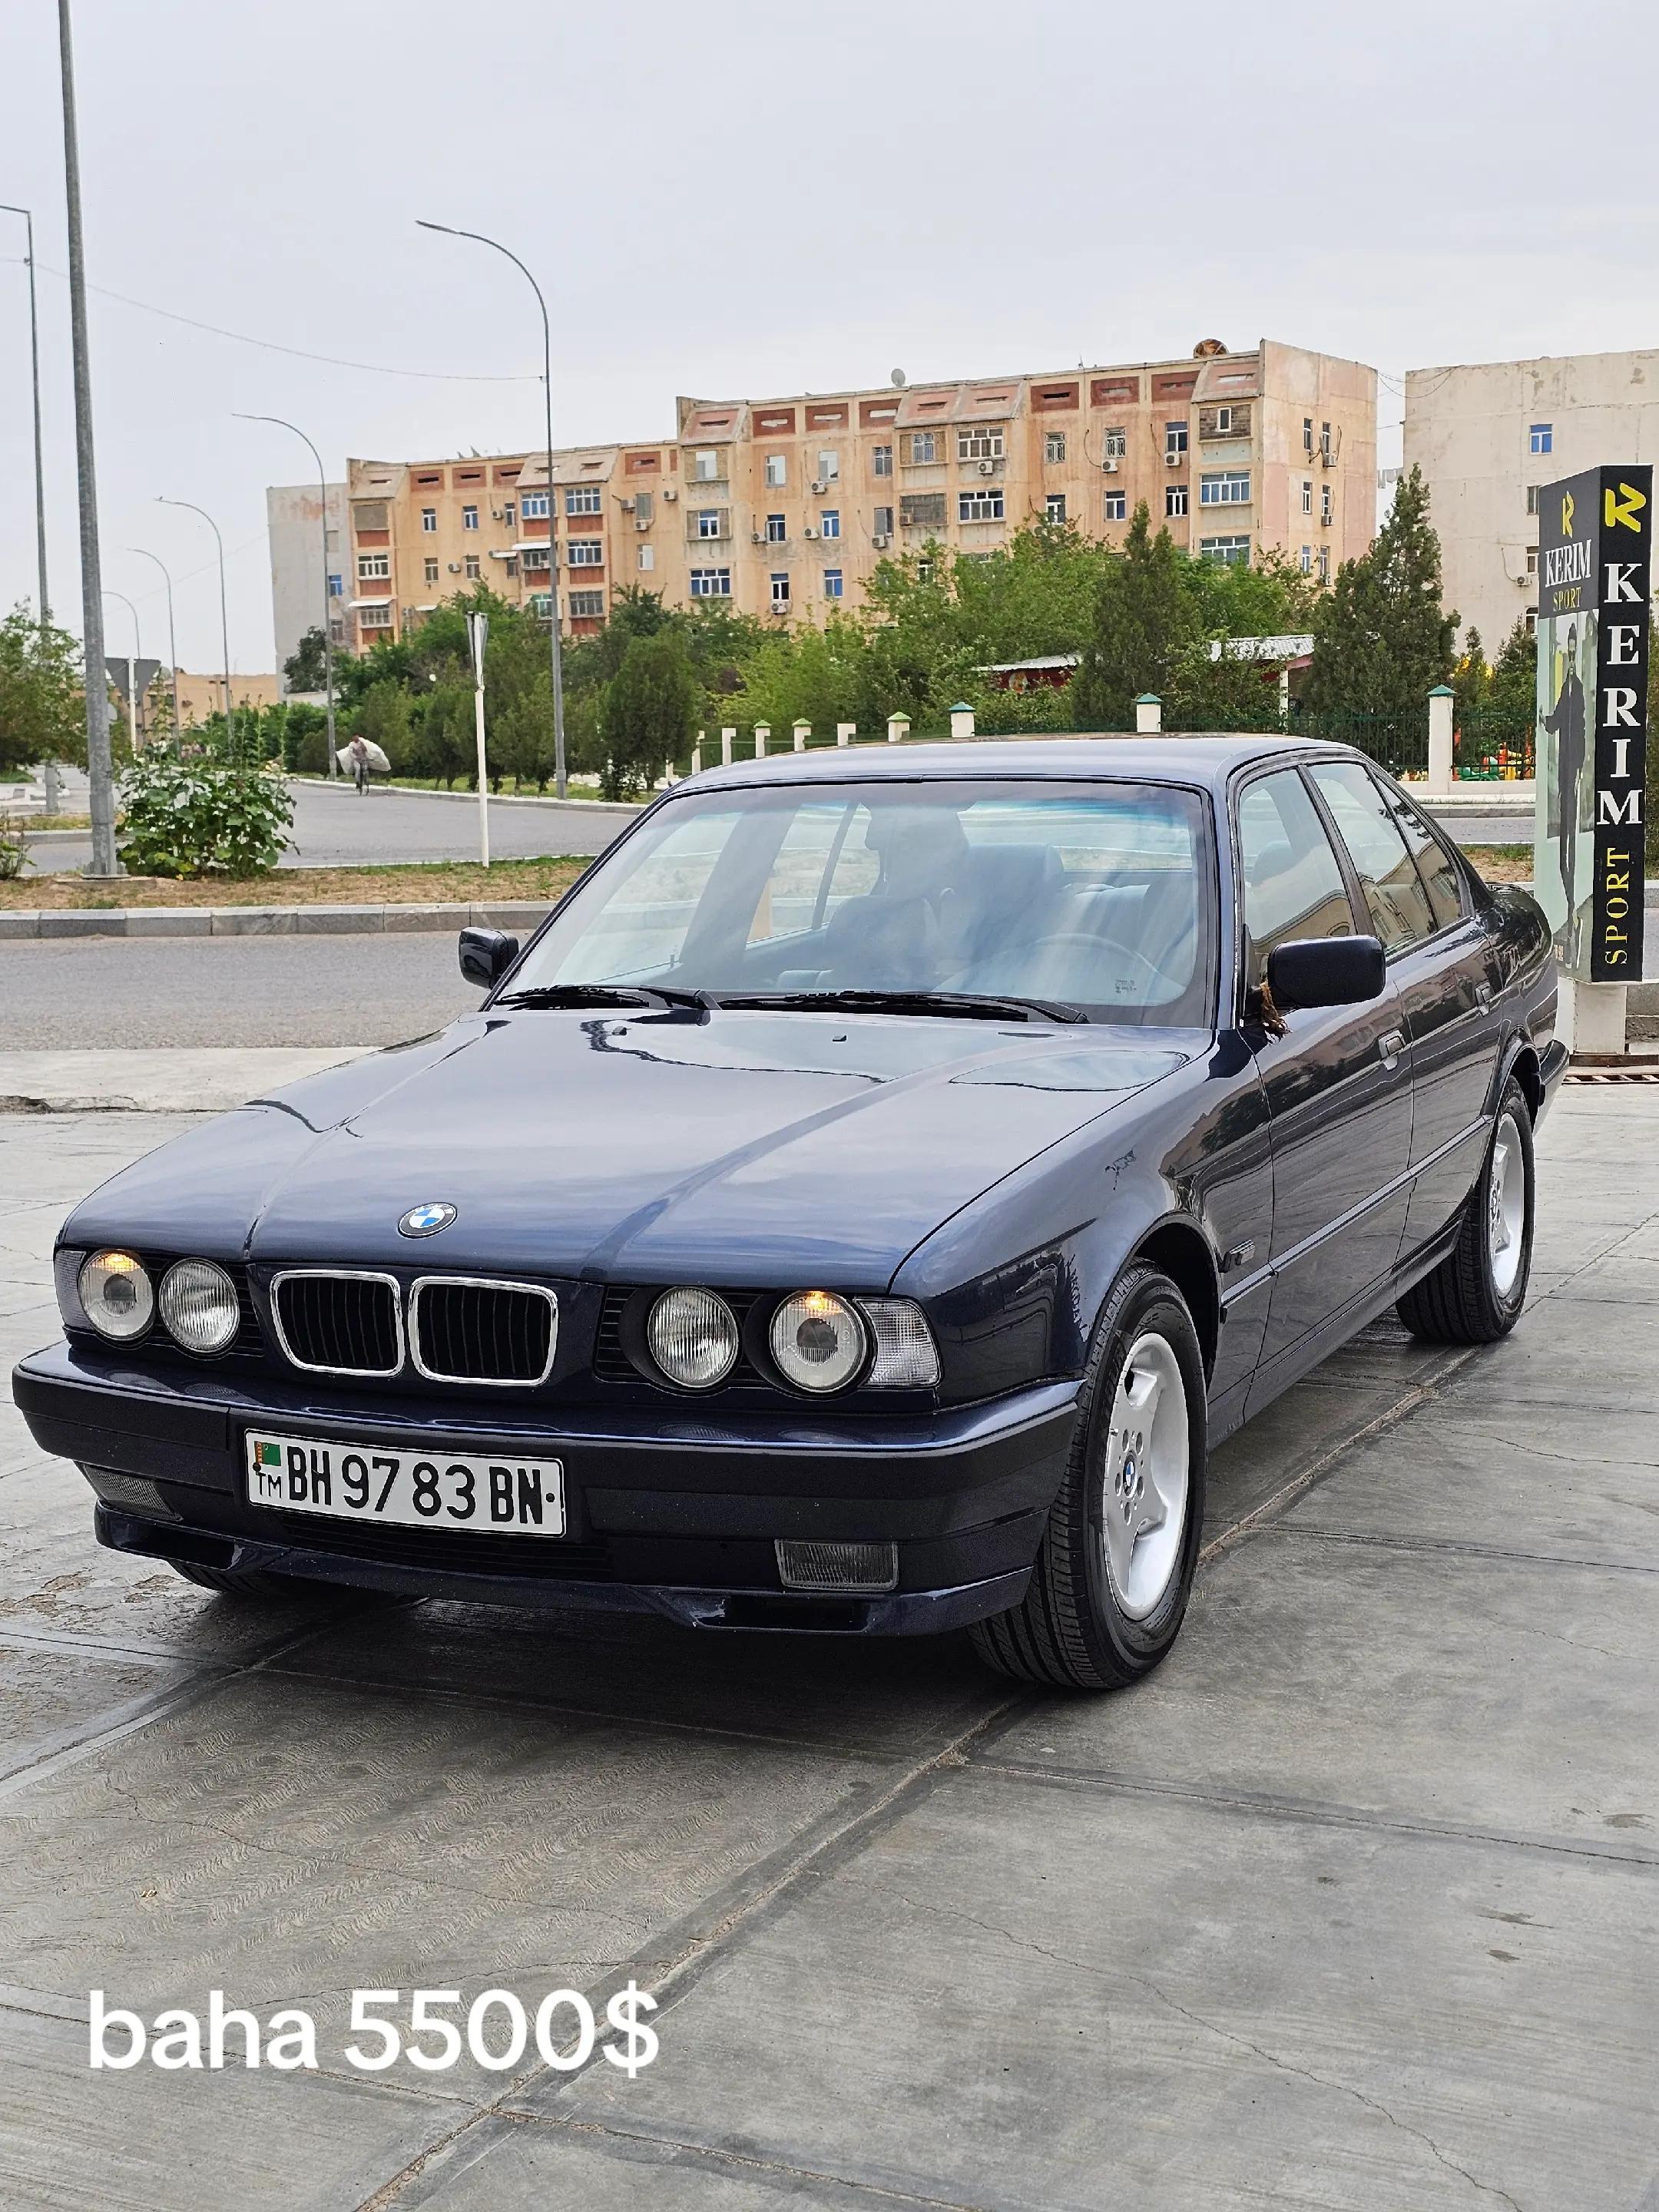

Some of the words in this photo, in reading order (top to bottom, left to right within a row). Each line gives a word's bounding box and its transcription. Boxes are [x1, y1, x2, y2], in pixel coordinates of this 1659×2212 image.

[1545, 539, 1592, 588] KERIM
[1553, 587, 1581, 611] SPORT
[1596, 563, 1644, 825] KERIM
[1605, 847, 1630, 965] SPORT
[257, 1472, 282, 1498] TM
[286, 1445, 332, 1505] BH
[341, 1454, 400, 1512] 97
[412, 1461, 476, 1519] 83
[488, 1465, 543, 1525] BN
